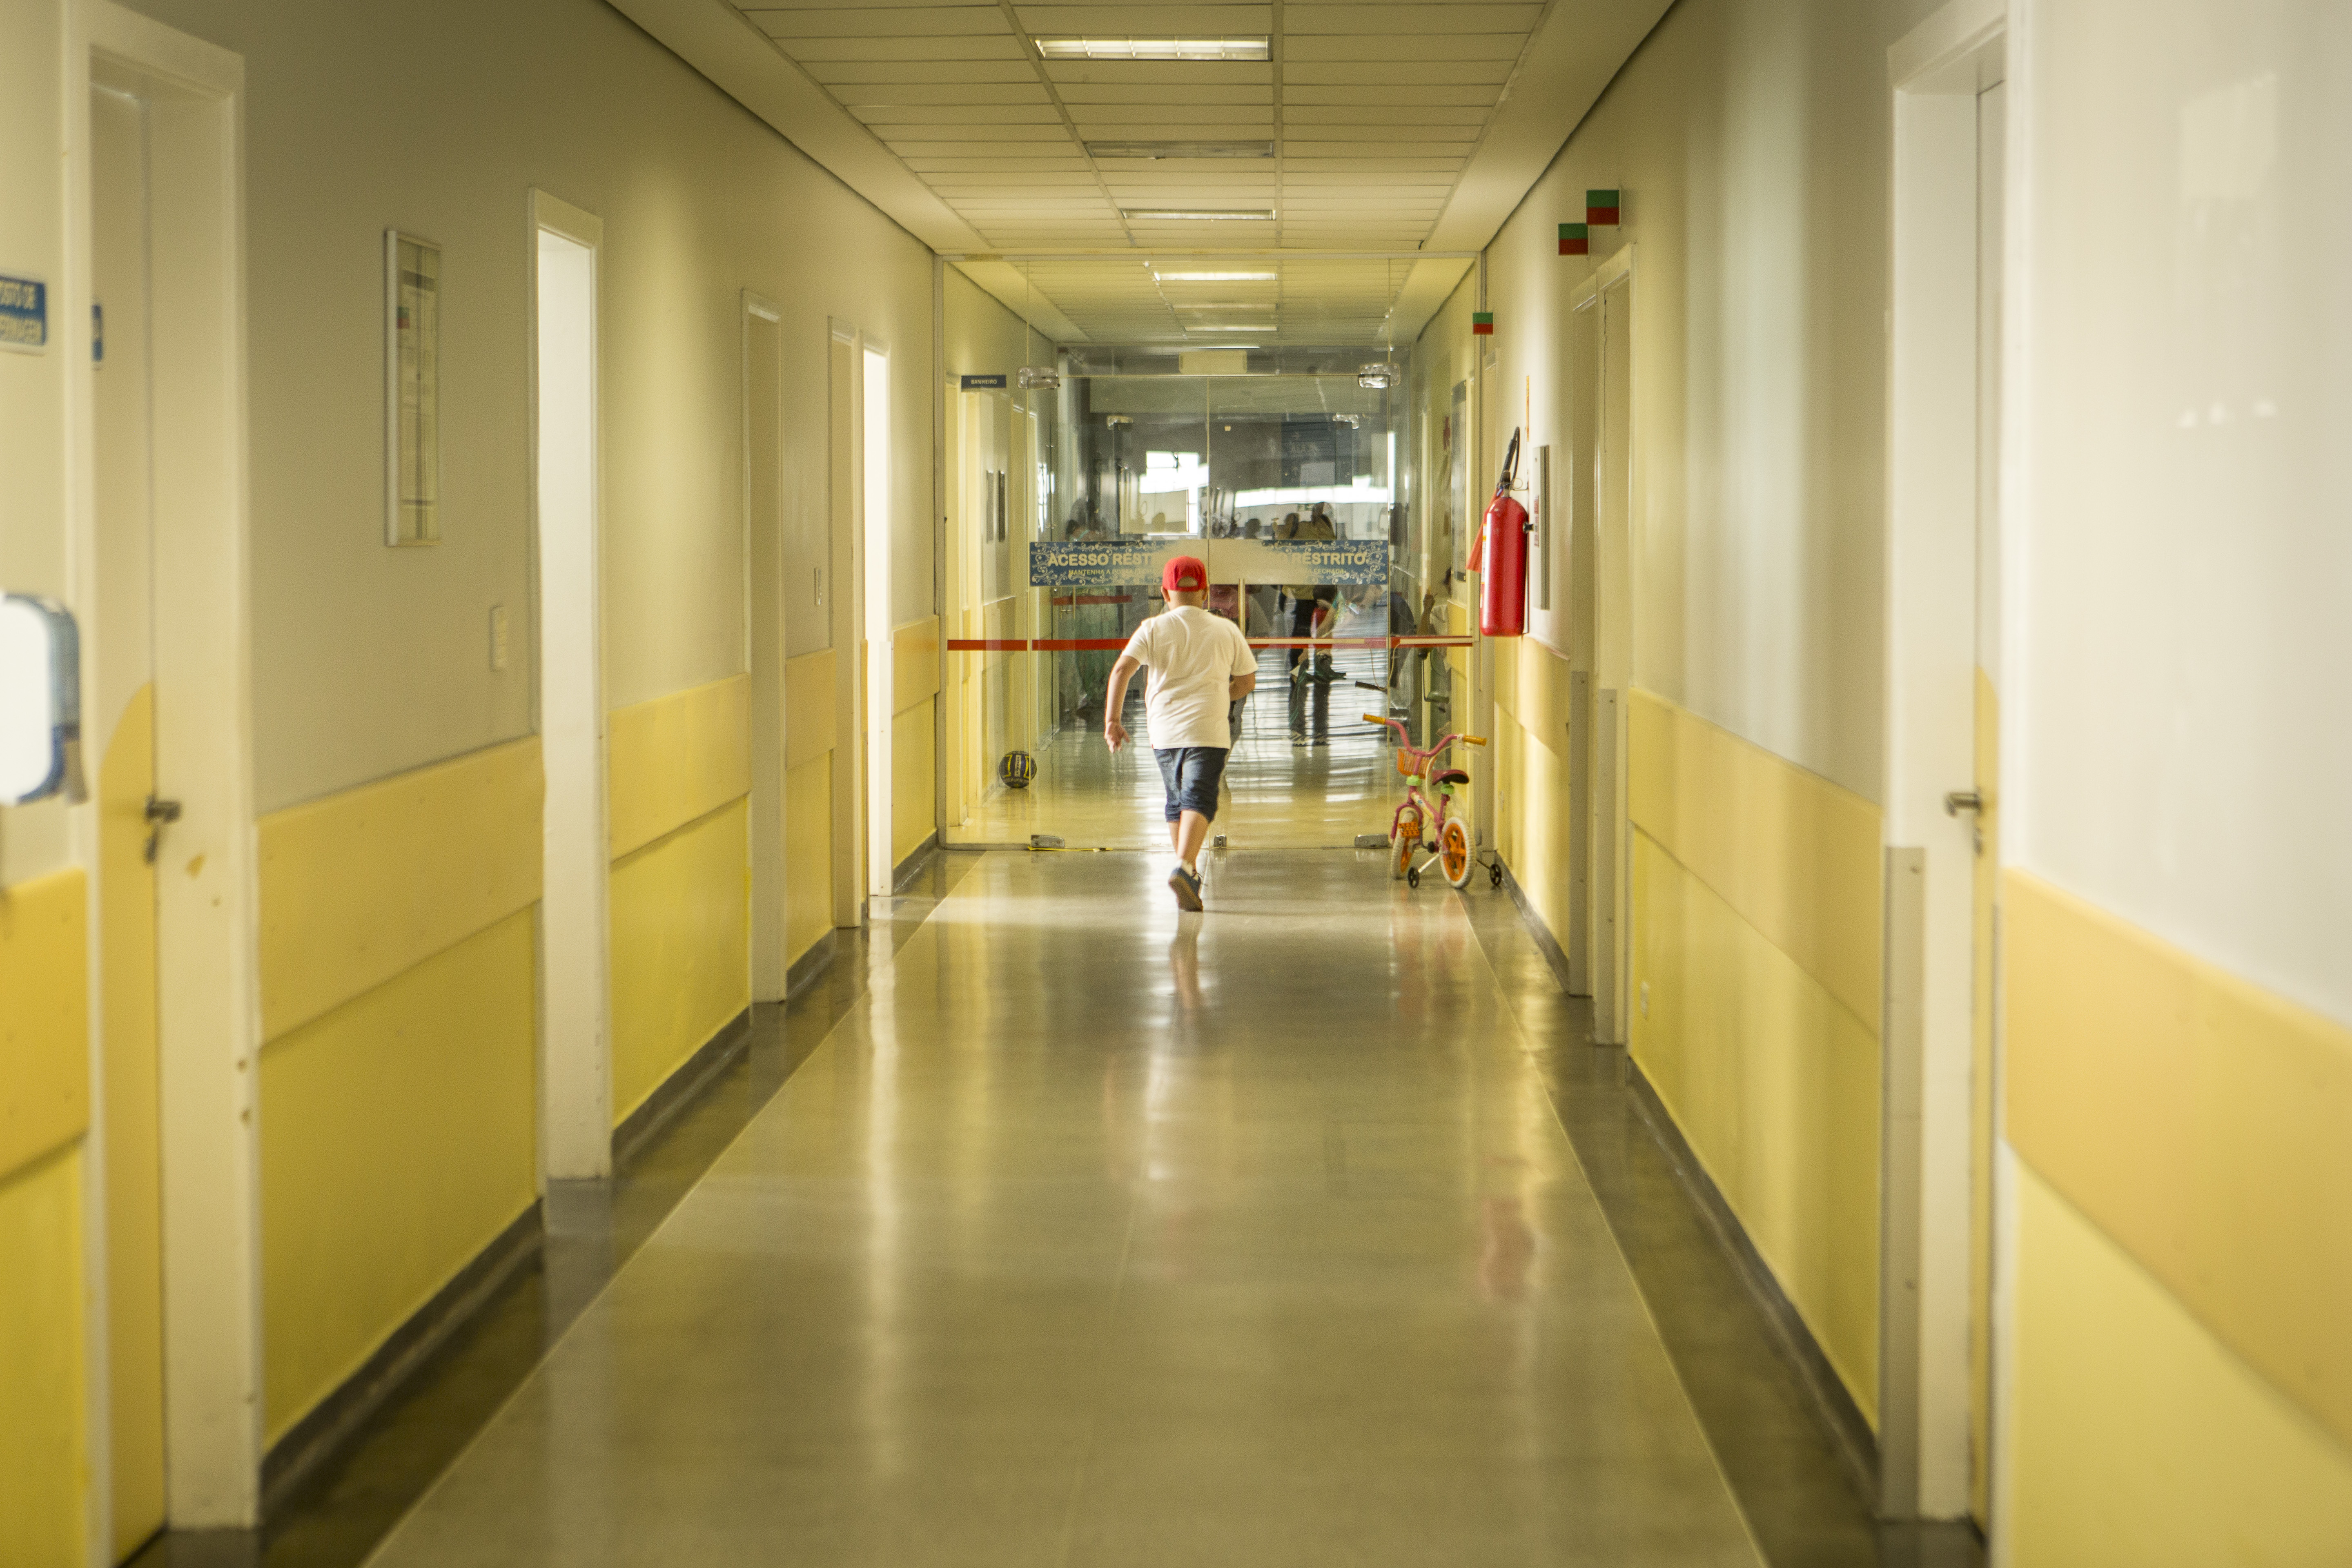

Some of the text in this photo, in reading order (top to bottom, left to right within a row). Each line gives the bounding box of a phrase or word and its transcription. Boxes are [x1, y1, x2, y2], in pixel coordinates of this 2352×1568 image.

[1048, 552, 1152, 566] ACESSO REST
[1292, 552, 1365, 566] RESTRITO
